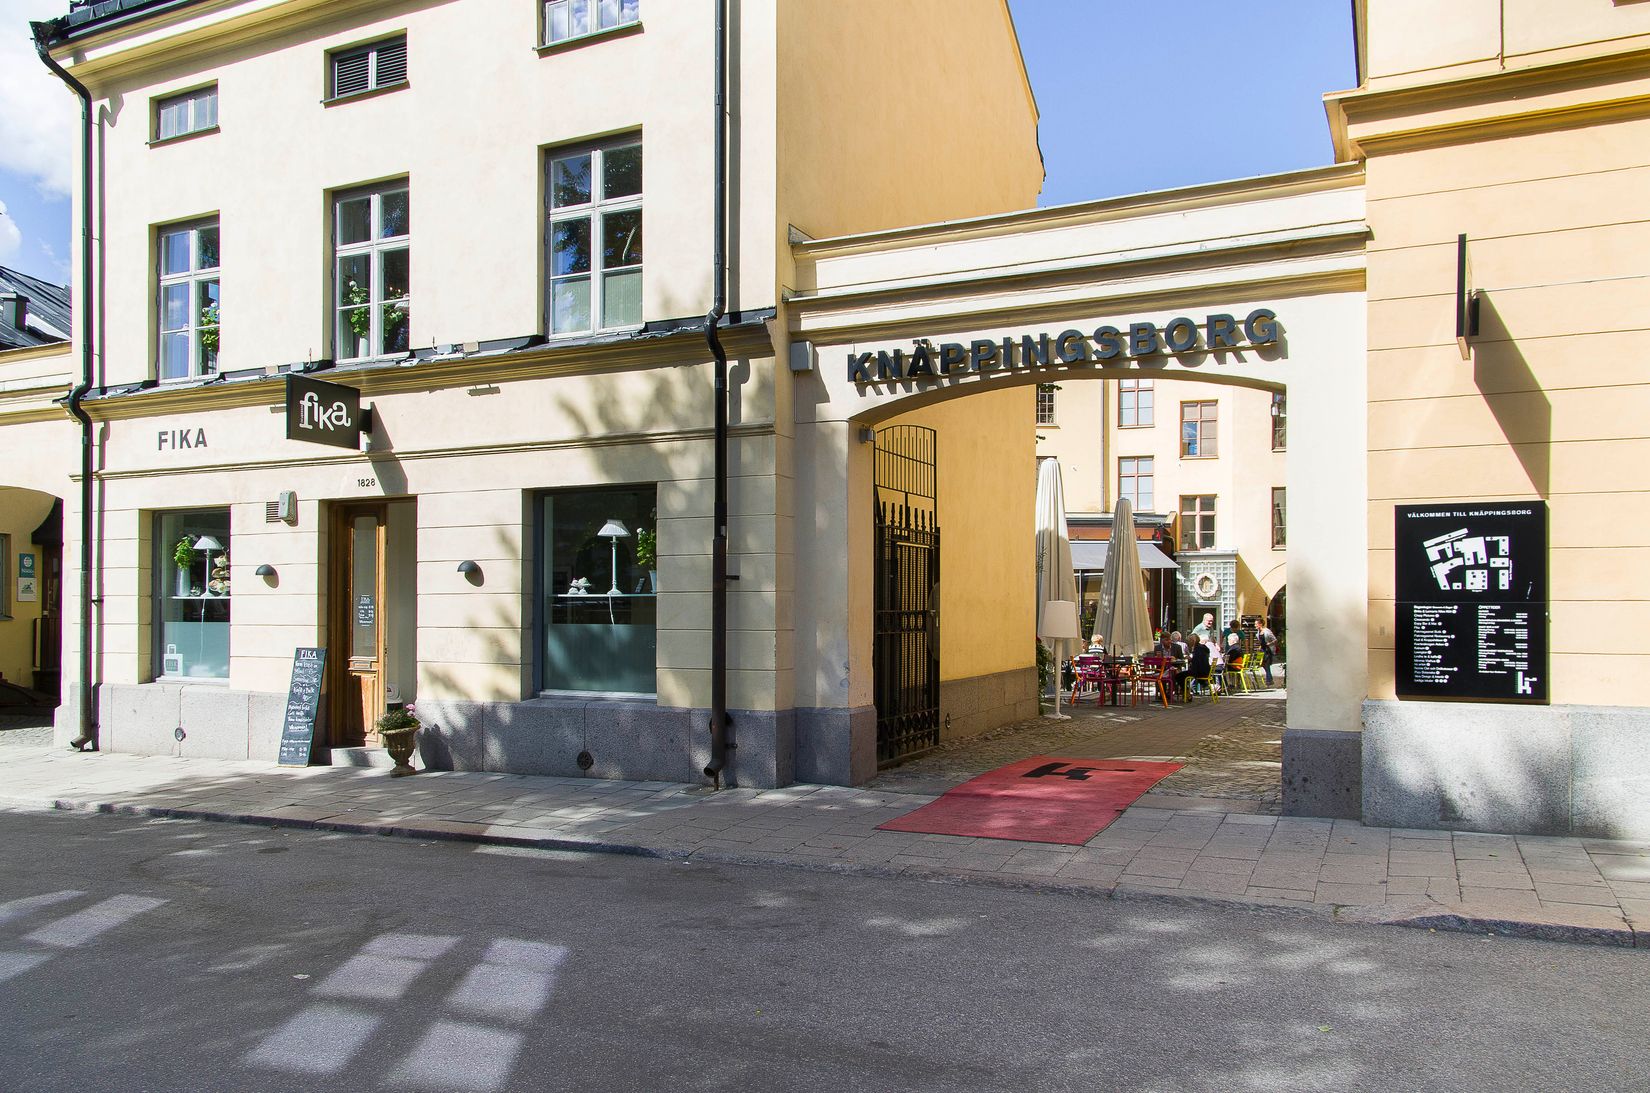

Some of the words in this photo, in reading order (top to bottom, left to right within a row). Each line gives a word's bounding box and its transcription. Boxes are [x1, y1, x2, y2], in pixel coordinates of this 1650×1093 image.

[847, 308, 1279, 382] KNÄPPINGSBORG
[299, 391, 352, 431] fika
[158, 428, 208, 451] FIKA
[357, 478, 376, 487] 1828
[300, 650, 317, 659] FIKA
